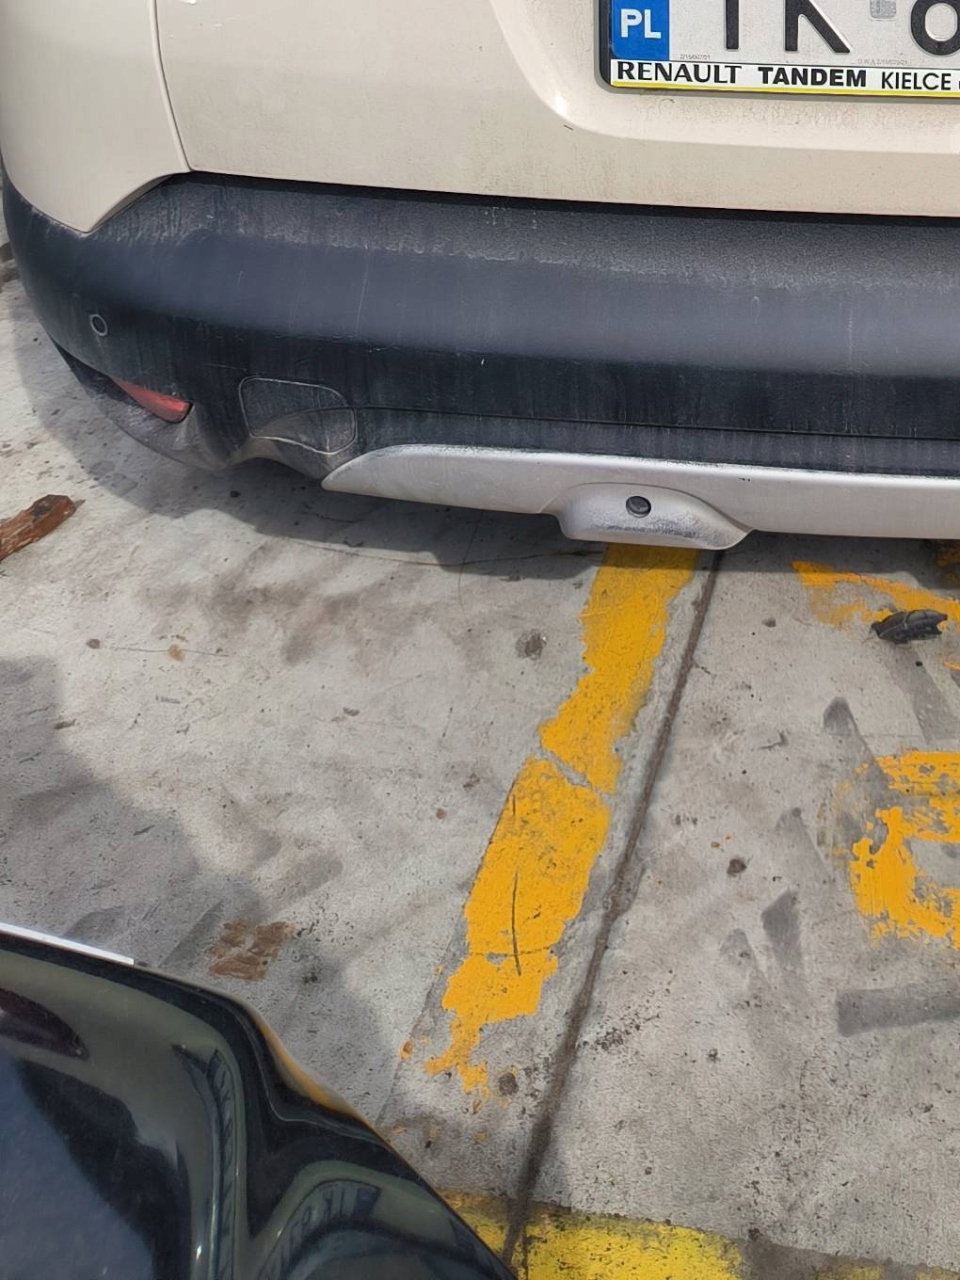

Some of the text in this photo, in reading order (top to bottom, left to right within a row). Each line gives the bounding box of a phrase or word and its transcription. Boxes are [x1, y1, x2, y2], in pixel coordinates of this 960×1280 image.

[621, 9, 661, 39] PL
[618, 62, 741, 83] RENAULT
[758, 67, 866, 88] TANDEM
[882, 72, 951, 91] KIELCE
